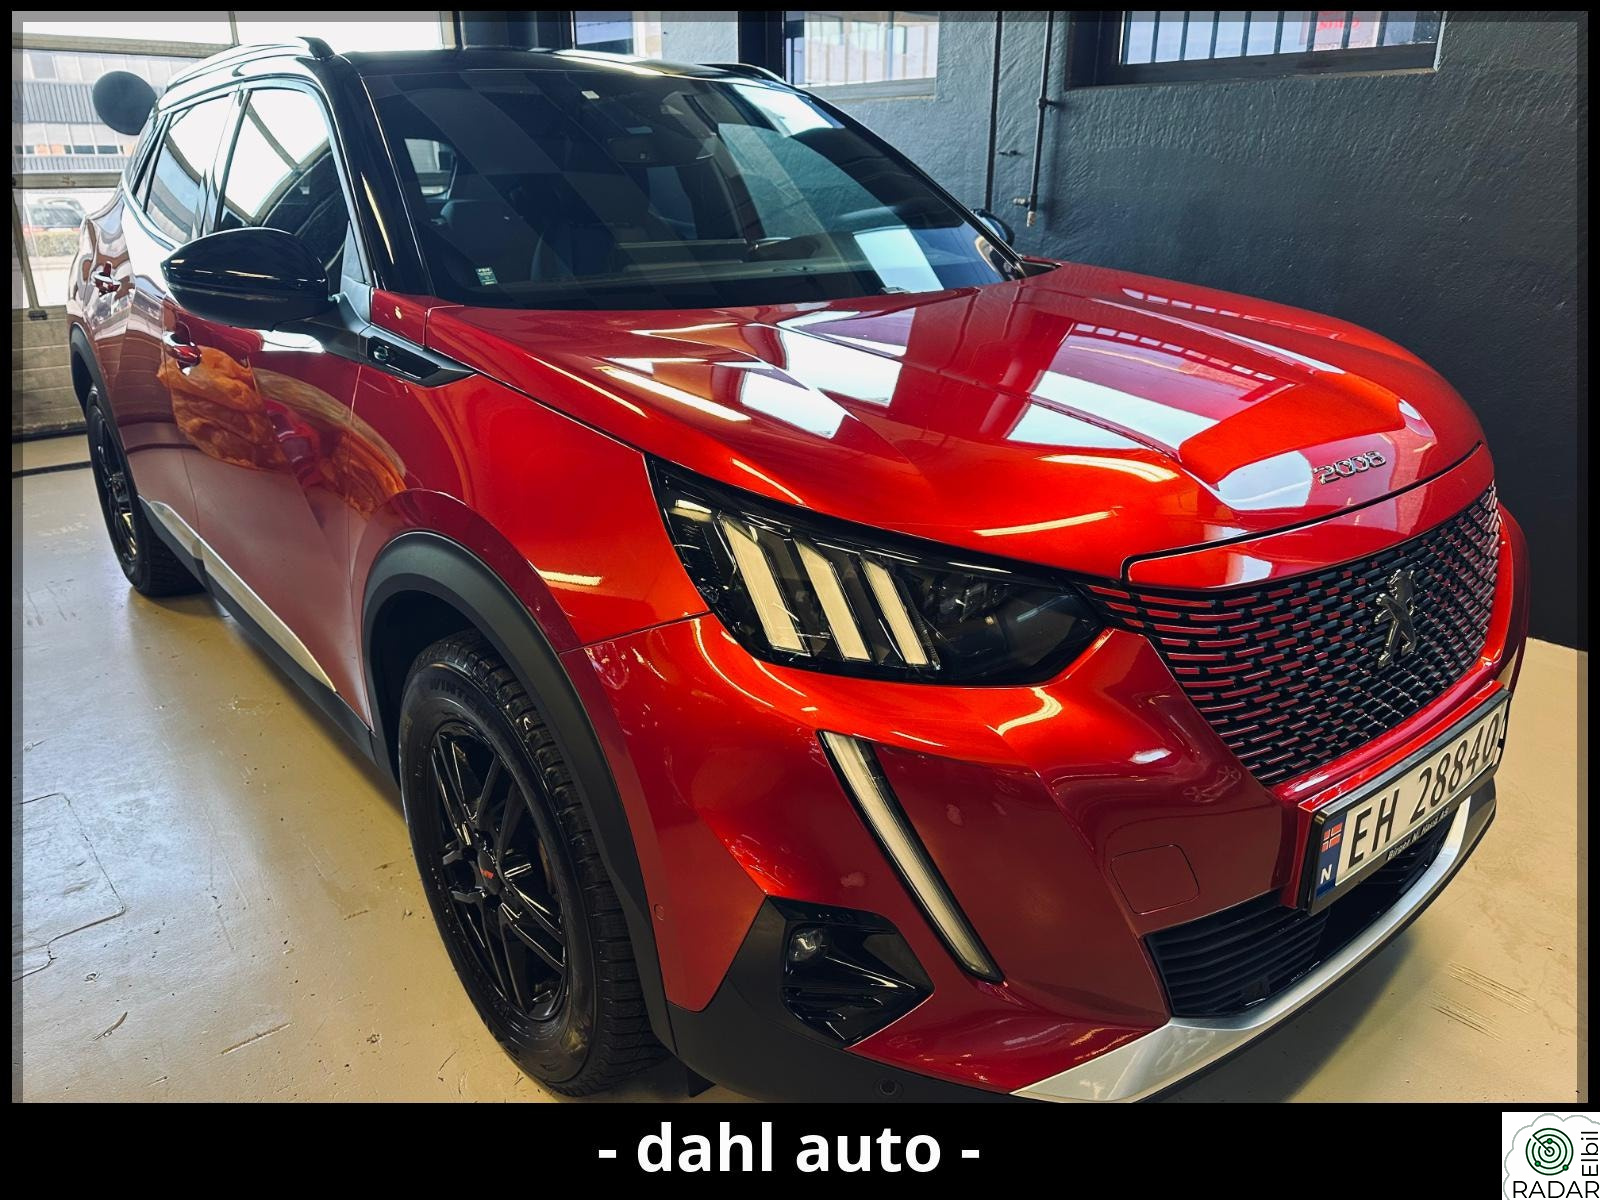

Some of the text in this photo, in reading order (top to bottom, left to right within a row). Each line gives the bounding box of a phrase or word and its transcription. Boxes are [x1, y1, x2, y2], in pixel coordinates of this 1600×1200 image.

[1312, 451, 1387, 485] 2008
[1347, 712, 1500, 869] EH 28840
[1320, 863, 1333, 885] N
